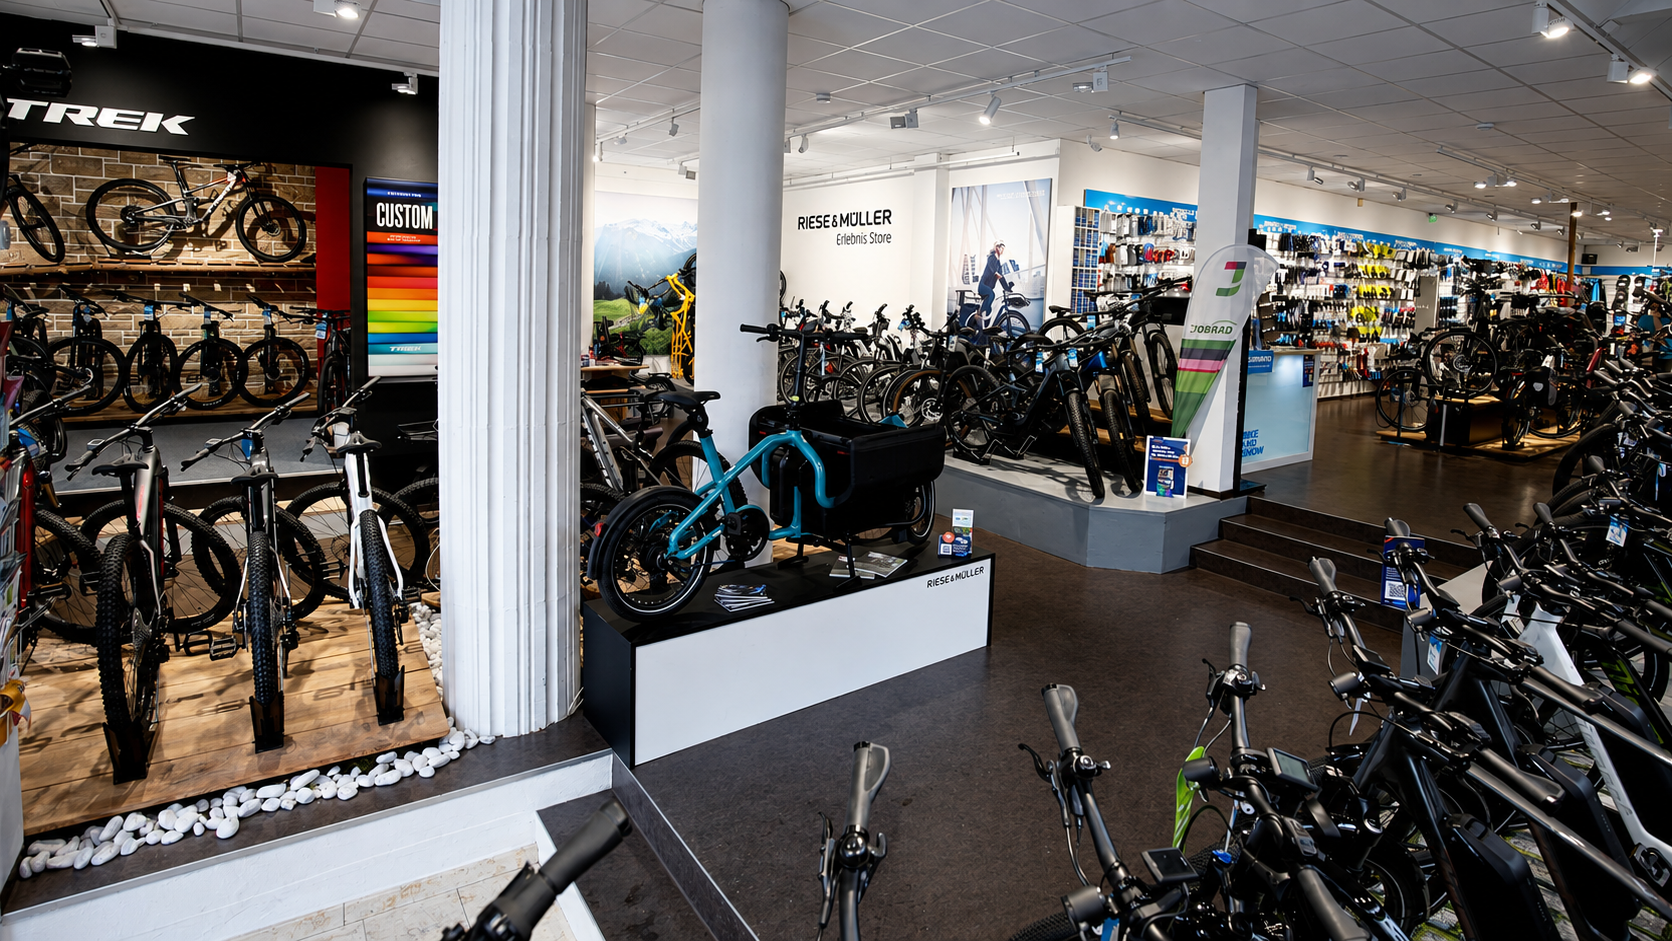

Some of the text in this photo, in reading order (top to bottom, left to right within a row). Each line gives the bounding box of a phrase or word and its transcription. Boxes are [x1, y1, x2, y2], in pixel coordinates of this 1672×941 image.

[7, 98, 195, 136] TREK
[376, 202, 433, 230] CUSTOM
[836, 231, 892, 246] Erlebnis Store
[1190, 325, 1233, 335] JOBRAD
